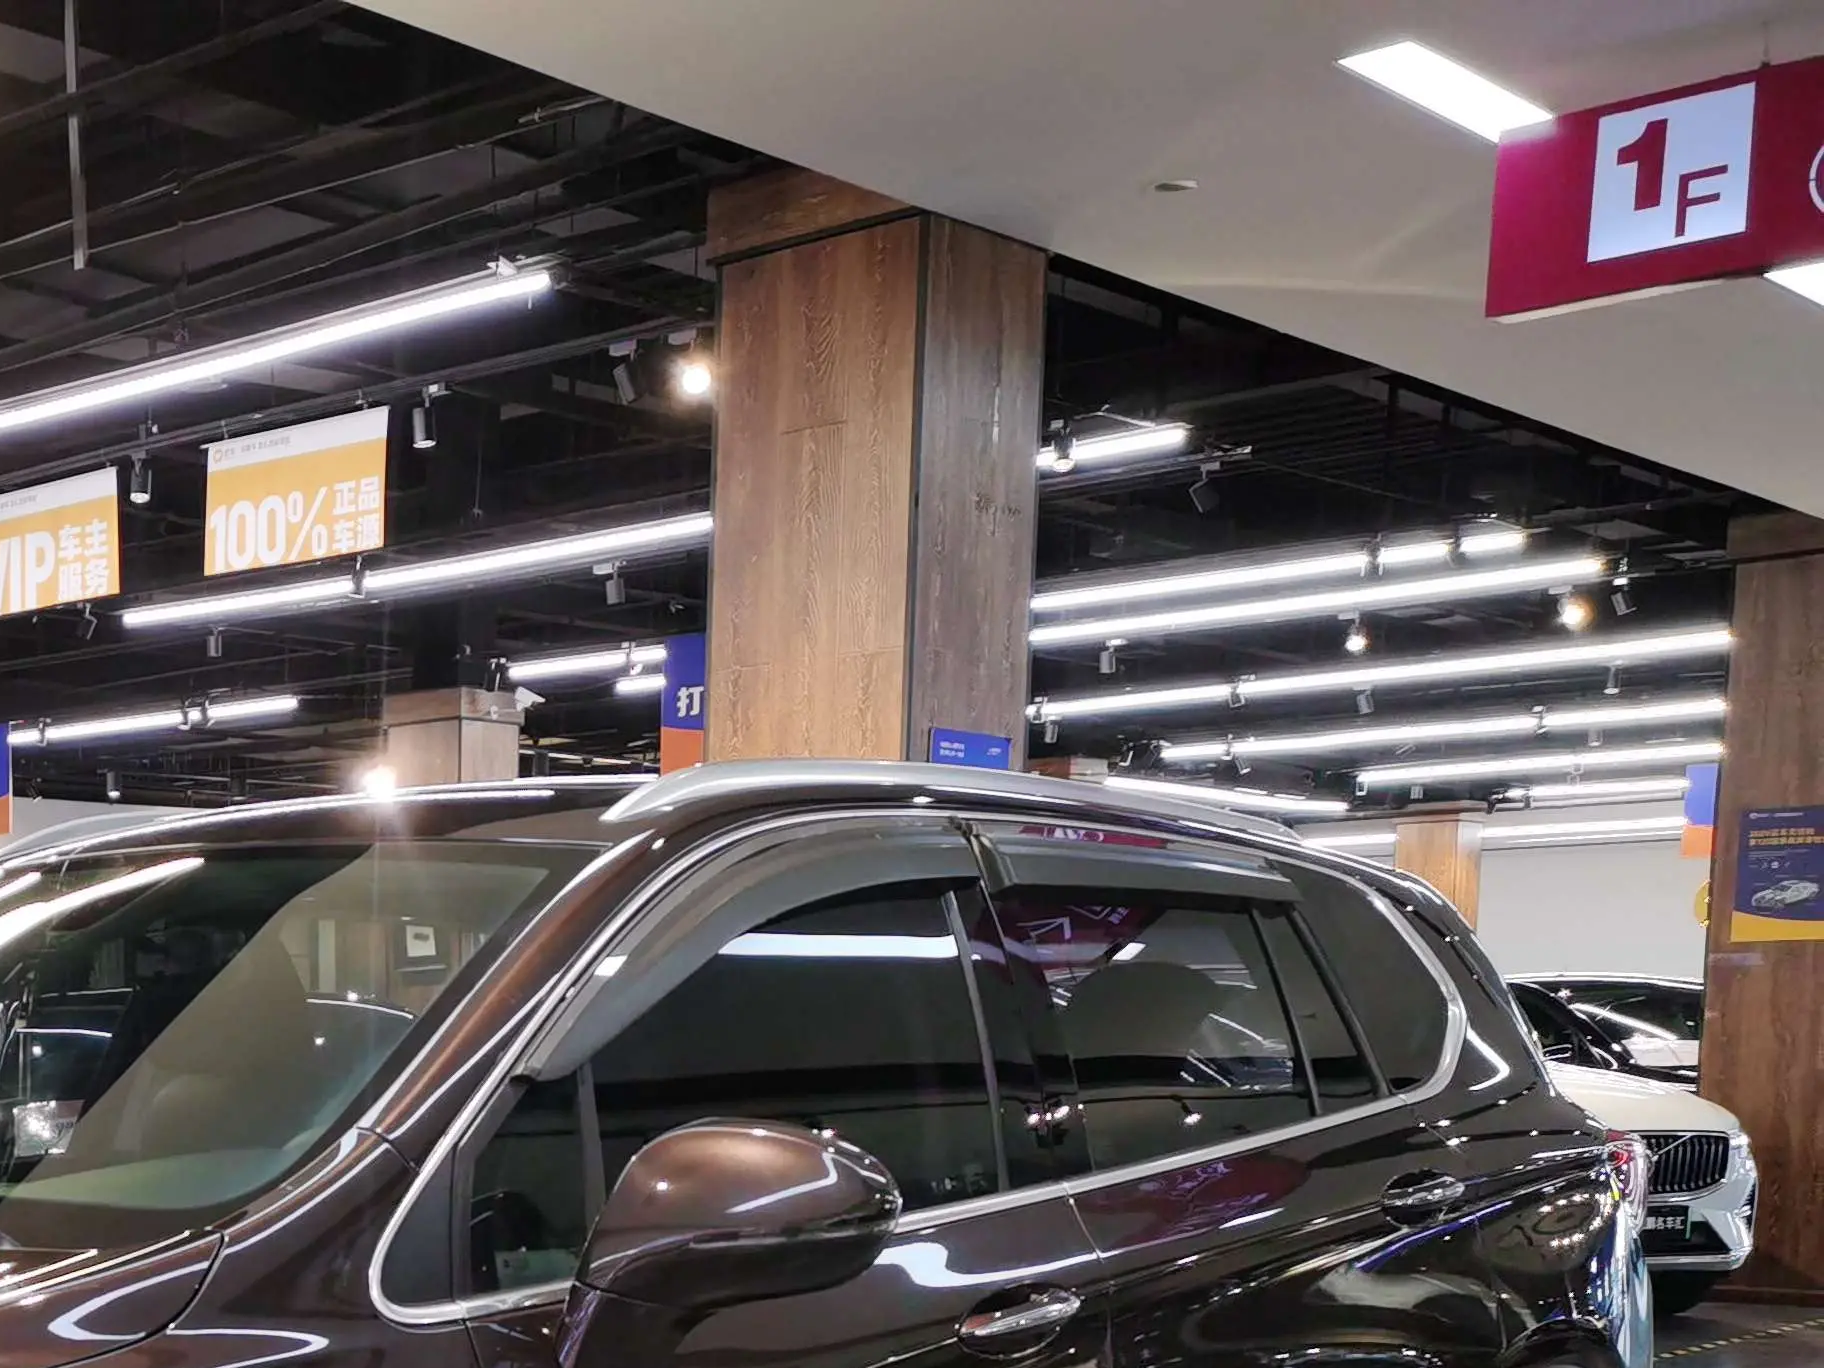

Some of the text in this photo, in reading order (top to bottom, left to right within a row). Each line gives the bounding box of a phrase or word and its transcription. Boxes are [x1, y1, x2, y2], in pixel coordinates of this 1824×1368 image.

[333, 476, 379, 515] 正品
[58, 519, 108, 560] 车主
[210, 485, 327, 574] 100%
[58, 558, 109, 601] 服务
[677, 686, 704, 717] 打
